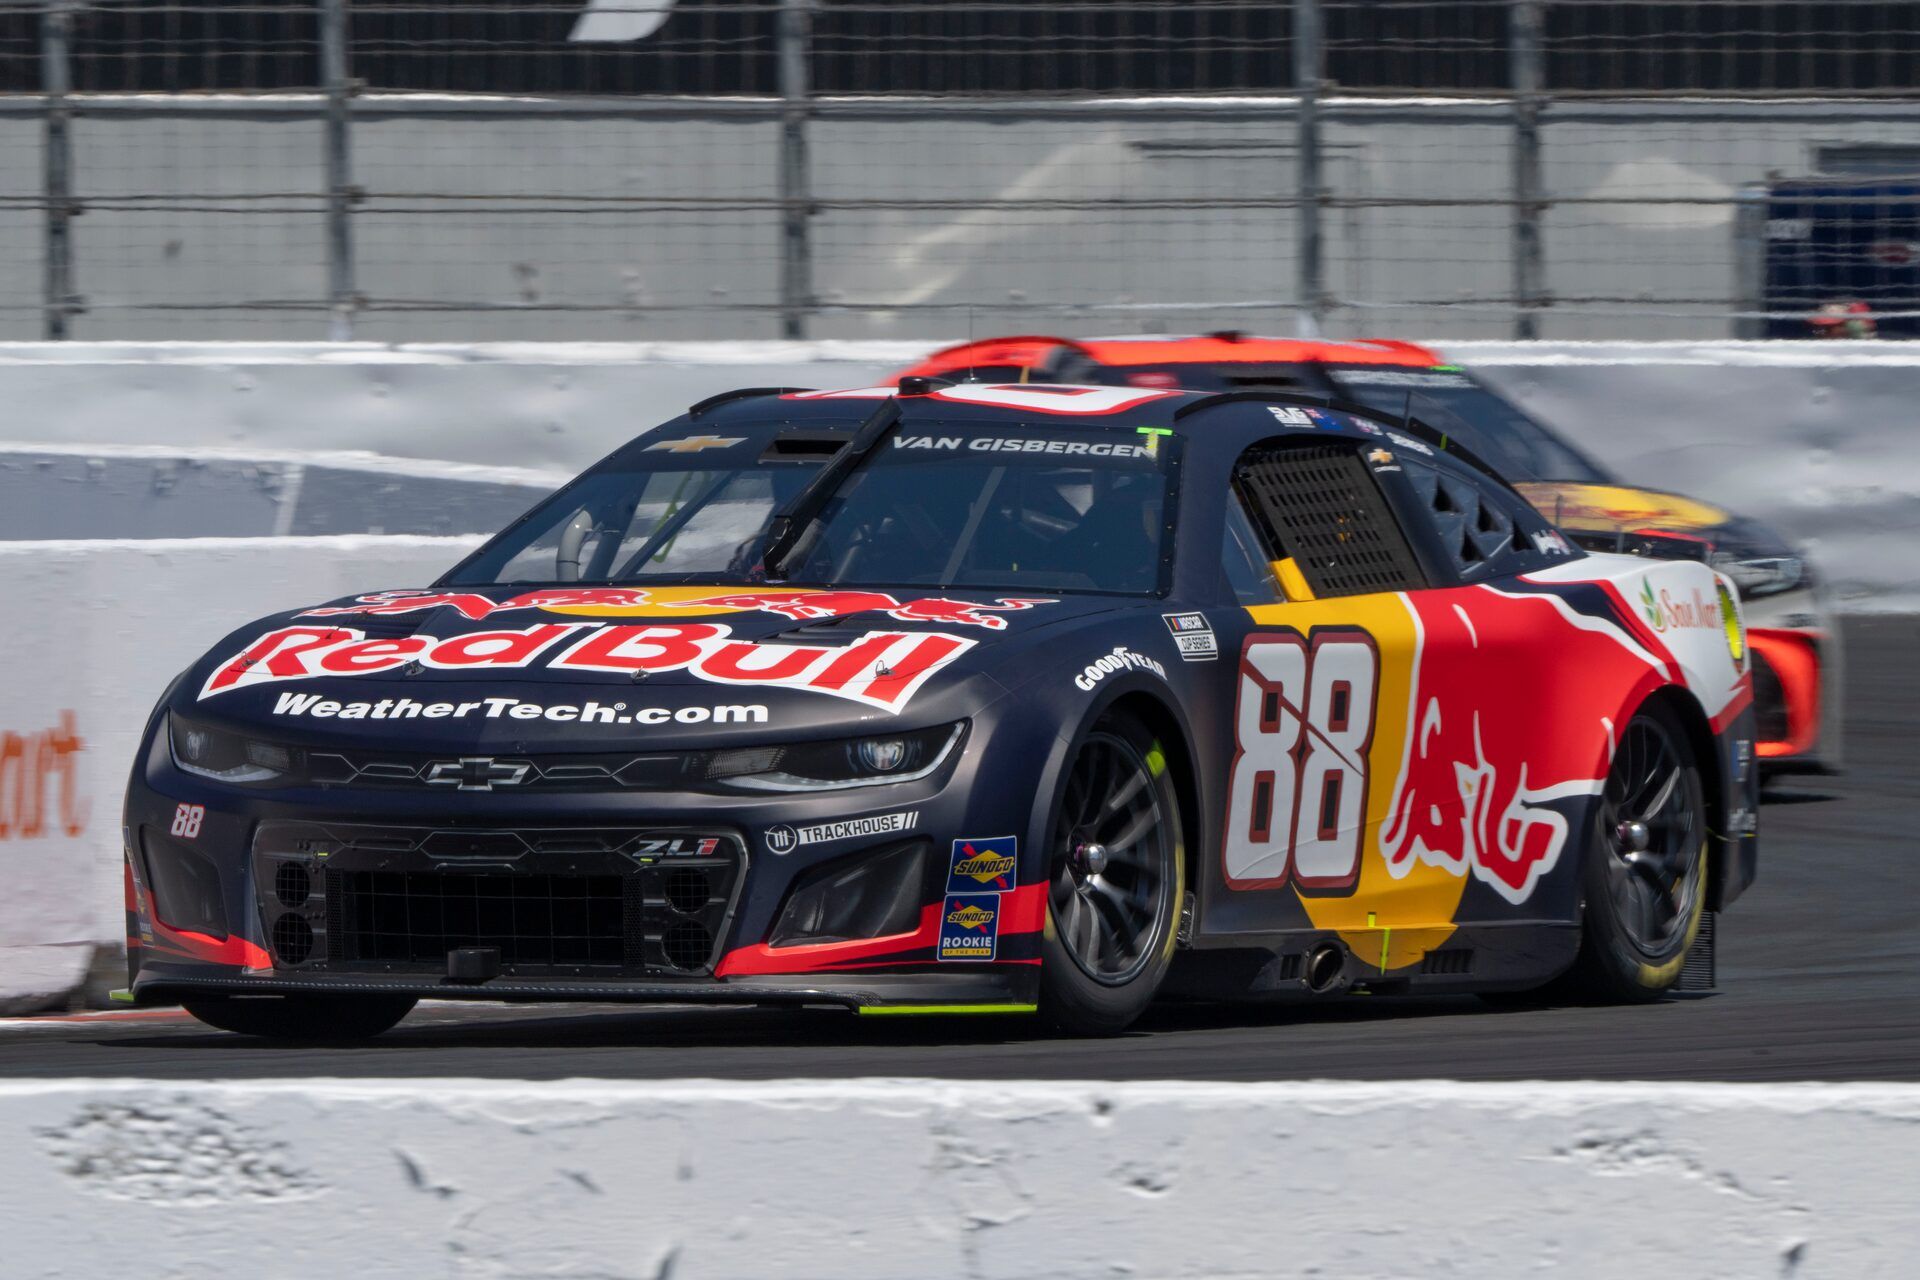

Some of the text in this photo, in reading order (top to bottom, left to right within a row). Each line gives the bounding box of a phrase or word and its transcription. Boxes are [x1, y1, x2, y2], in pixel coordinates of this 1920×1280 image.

[893, 436, 1157, 459] VAN GISBERGEN
[197, 621, 979, 716] Red Bull
[1074, 646, 1168, 692] GOODYEAR
[1223, 630, 1377, 893] 88
[170, 803, 205, 838] 88
[802, 815, 900, 843] TRACKHOUSE
[632, 838, 719, 857] ZL1
[955, 858, 1012, 874] SUNOCO
[949, 912, 993, 922] SUNOCO
[942, 937, 992, 948] ROOKIE
